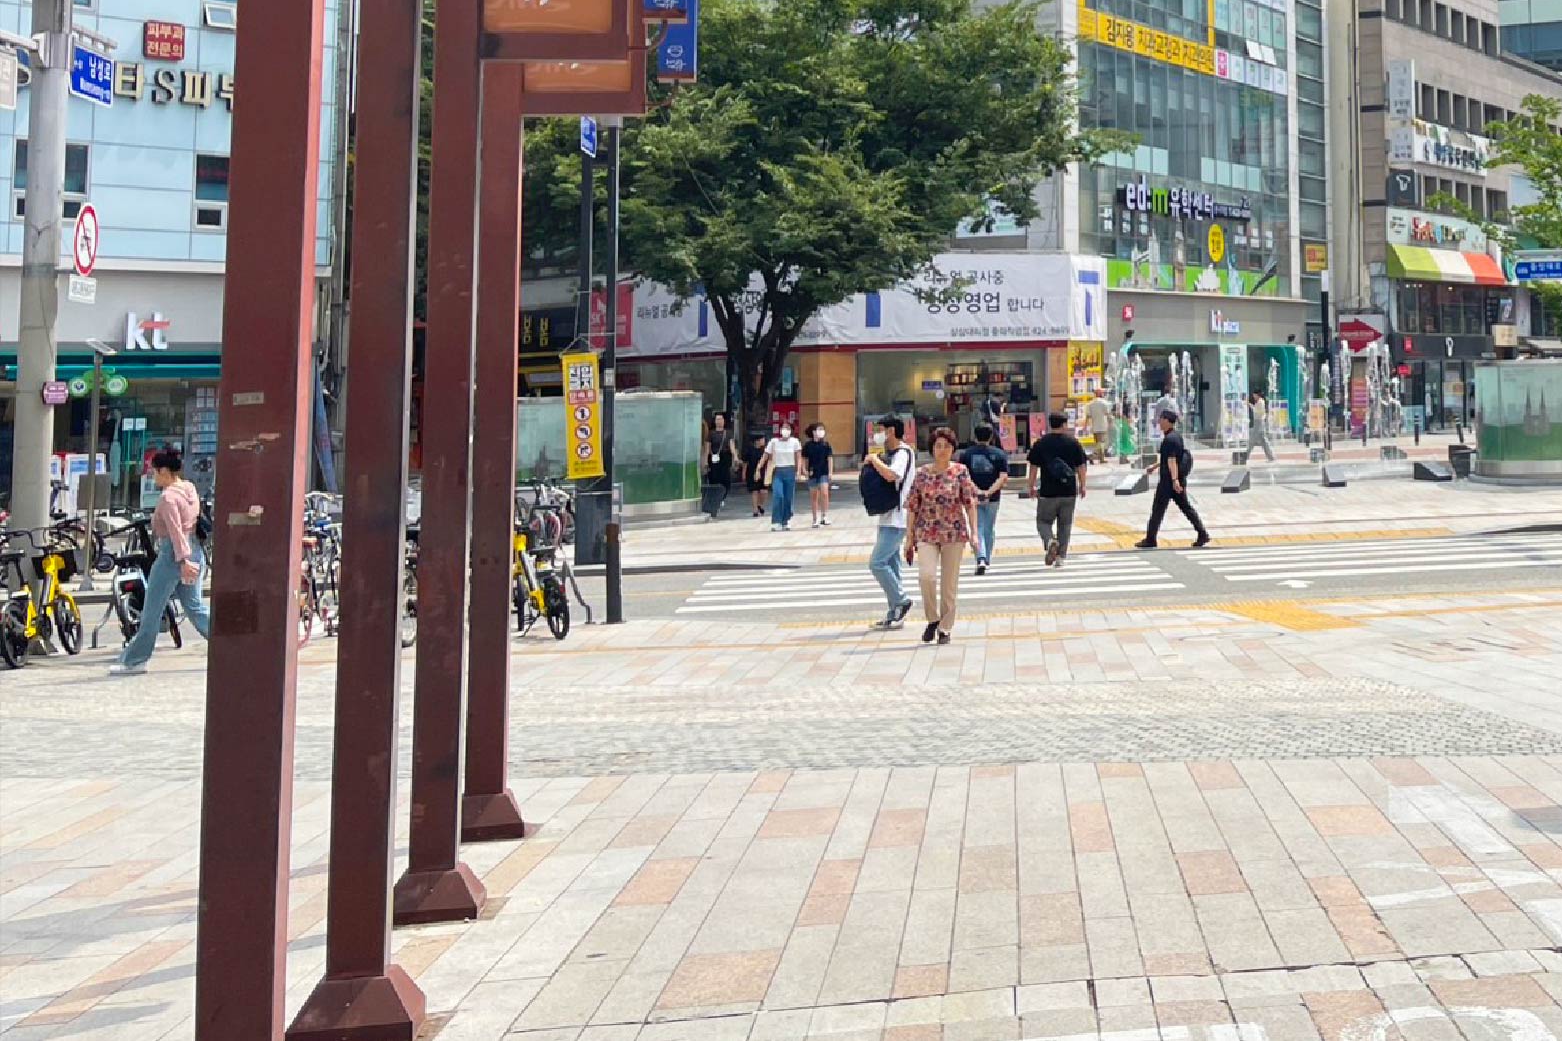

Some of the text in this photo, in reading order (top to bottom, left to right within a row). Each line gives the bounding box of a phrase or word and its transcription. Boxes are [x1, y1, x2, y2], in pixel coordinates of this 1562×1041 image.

[147, 23, 184, 39] 피부과
[146, 41, 184, 57] 전문의
[1171, 187, 1215, 221] 유학센터
[1008, 298, 1044, 312] 합니다
[125, 311, 171, 350] kt
